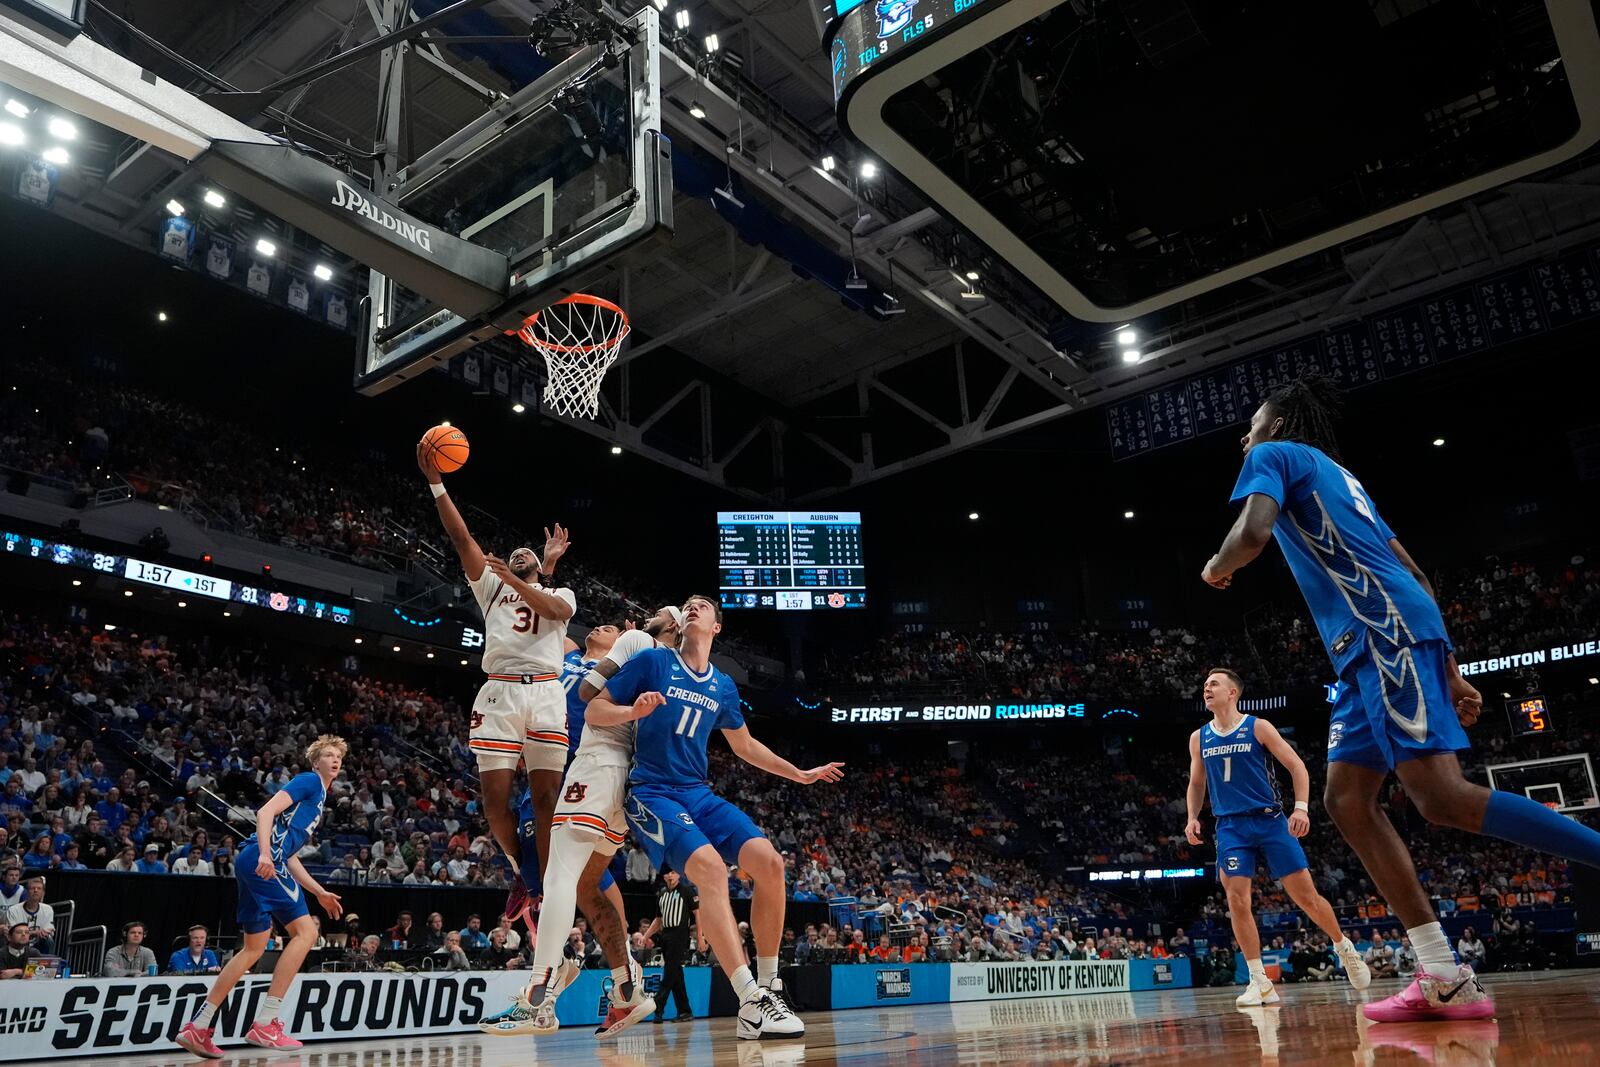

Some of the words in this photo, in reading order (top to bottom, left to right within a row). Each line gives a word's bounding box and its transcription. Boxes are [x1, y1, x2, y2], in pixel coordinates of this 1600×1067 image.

[953, 0, 977, 13] BO
[902, 20, 925, 42] FLS
[924, 13, 934, 28] 5
[858, 46, 880, 65] TOL
[880, 40, 889, 53] 3
[331, 179, 432, 253] SPALDING
[1536, 264, 1563, 313] NCAA
[1482, 284, 1504, 330] NCAA
[1520, 287, 1541, 330] 1984
[1427, 302, 1449, 347] NCAA
[1464, 303, 1484, 347] 1978
[1376, 319, 1396, 364] NCAA
[1412, 321, 1430, 364] 1975
[1277, 351, 1291, 384] NCA
[1326, 334, 1344, 378] NCAA
[1361, 337, 1377, 381] 1966
[1234, 364, 1251, 406] NCAA
[1150, 393, 1164, 433] NCAA
[1191, 380, 1208, 421] NCAA
[1222, 383, 1236, 422] 1949
[1110, 408, 1123, 447] NCAA
[1136, 411, 1149, 448] 1942
[6, 532, 19, 542] FLS
[6, 541, 15, 551] 5
[31, 546, 39, 557] 3
[92, 553, 115, 572] 32
[137, 563, 172, 584] 1:57
[194, 577, 217, 593] 1ST
[241, 586, 258, 603] 31
[761, 596, 774, 605] 32
[786, 599, 803, 608] 1:57
[814, 596, 826, 605] 31
[1027, 602, 1046, 611] 219
[1126, 600, 1145, 609] 219
[71, 605, 87, 619] 14
[512, 606, 540, 635] 31
[1130, 621, 1149, 629] 219
[1030, 622, 1049, 630] 219
[344, 655, 357, 670] 15
[1458, 650, 1545, 676] REIGHTON
[665, 685, 720, 713] CREIGHTON
[1520, 699, 1544, 713] 1:57
[675, 704, 702, 738] 11
[850, 707, 903, 722] FIRST
[922, 705, 991, 721] SECOND
[996, 703, 1066, 719] ROUNDS
[1529, 710, 1545, 730] 5
[1202, 743, 1252, 759] CREIGHTON
[1222, 757, 1232, 783] 1
[882, 971, 902, 983] MARCH
[886, 982, 911, 994] MADNESS
[957, 976, 976, 986] HOSTED
[987, 966, 1055, 994] UNIVERSITY
[1059, 965, 1072, 990] OF
[1075, 964, 1125, 989] KENTUCKY
[291, 977, 488, 1033] ROUNDS
